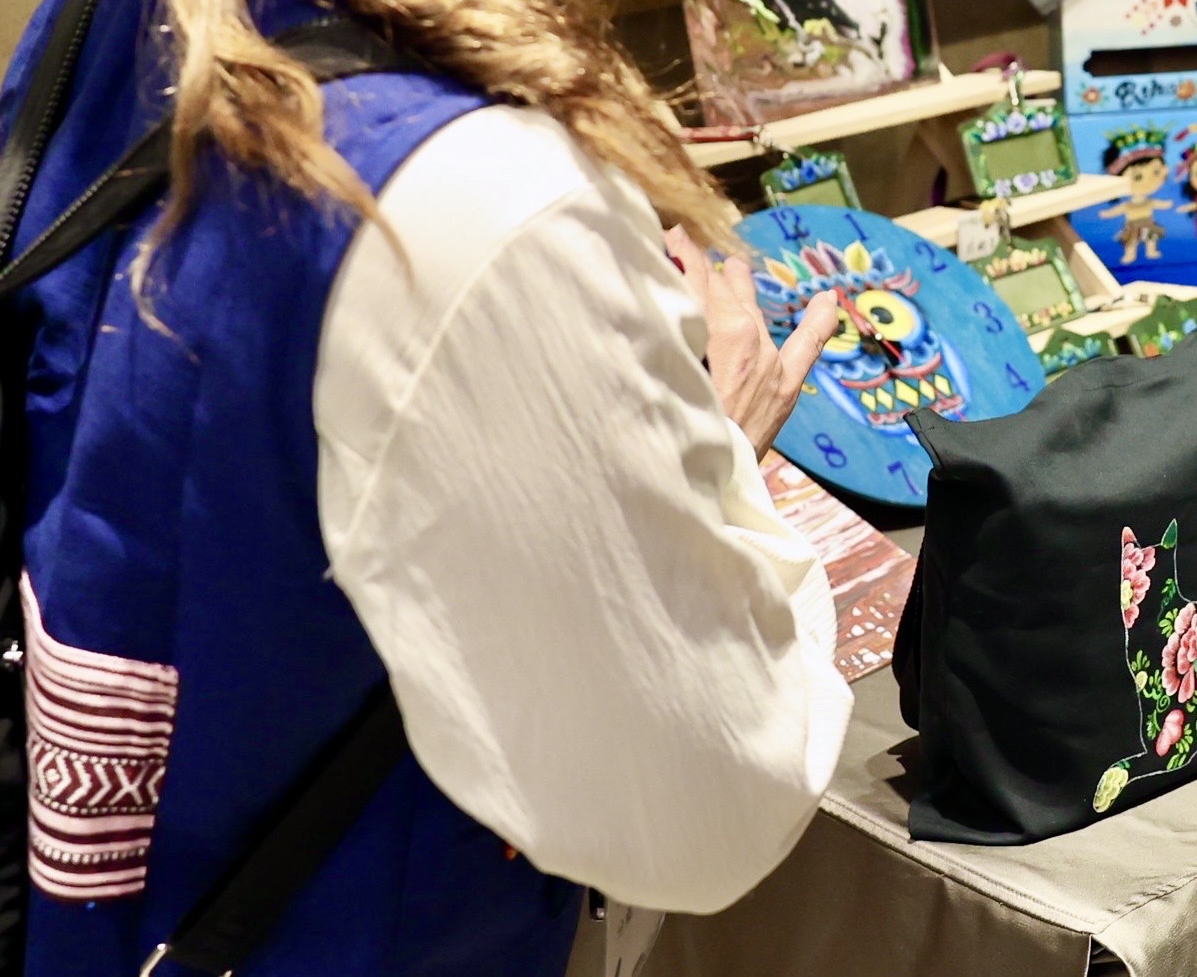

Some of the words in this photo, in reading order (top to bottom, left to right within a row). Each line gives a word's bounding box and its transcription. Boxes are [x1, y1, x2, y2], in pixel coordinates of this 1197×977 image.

[771, 207, 810, 241] 12
[845, 213, 870, 241] 1
[916, 241, 947, 272] 2
[974, 301, 1004, 334] 3
[1005, 362, 1031, 393] 4
[814, 432, 847, 468] 8
[888, 460, 923, 496] 7
